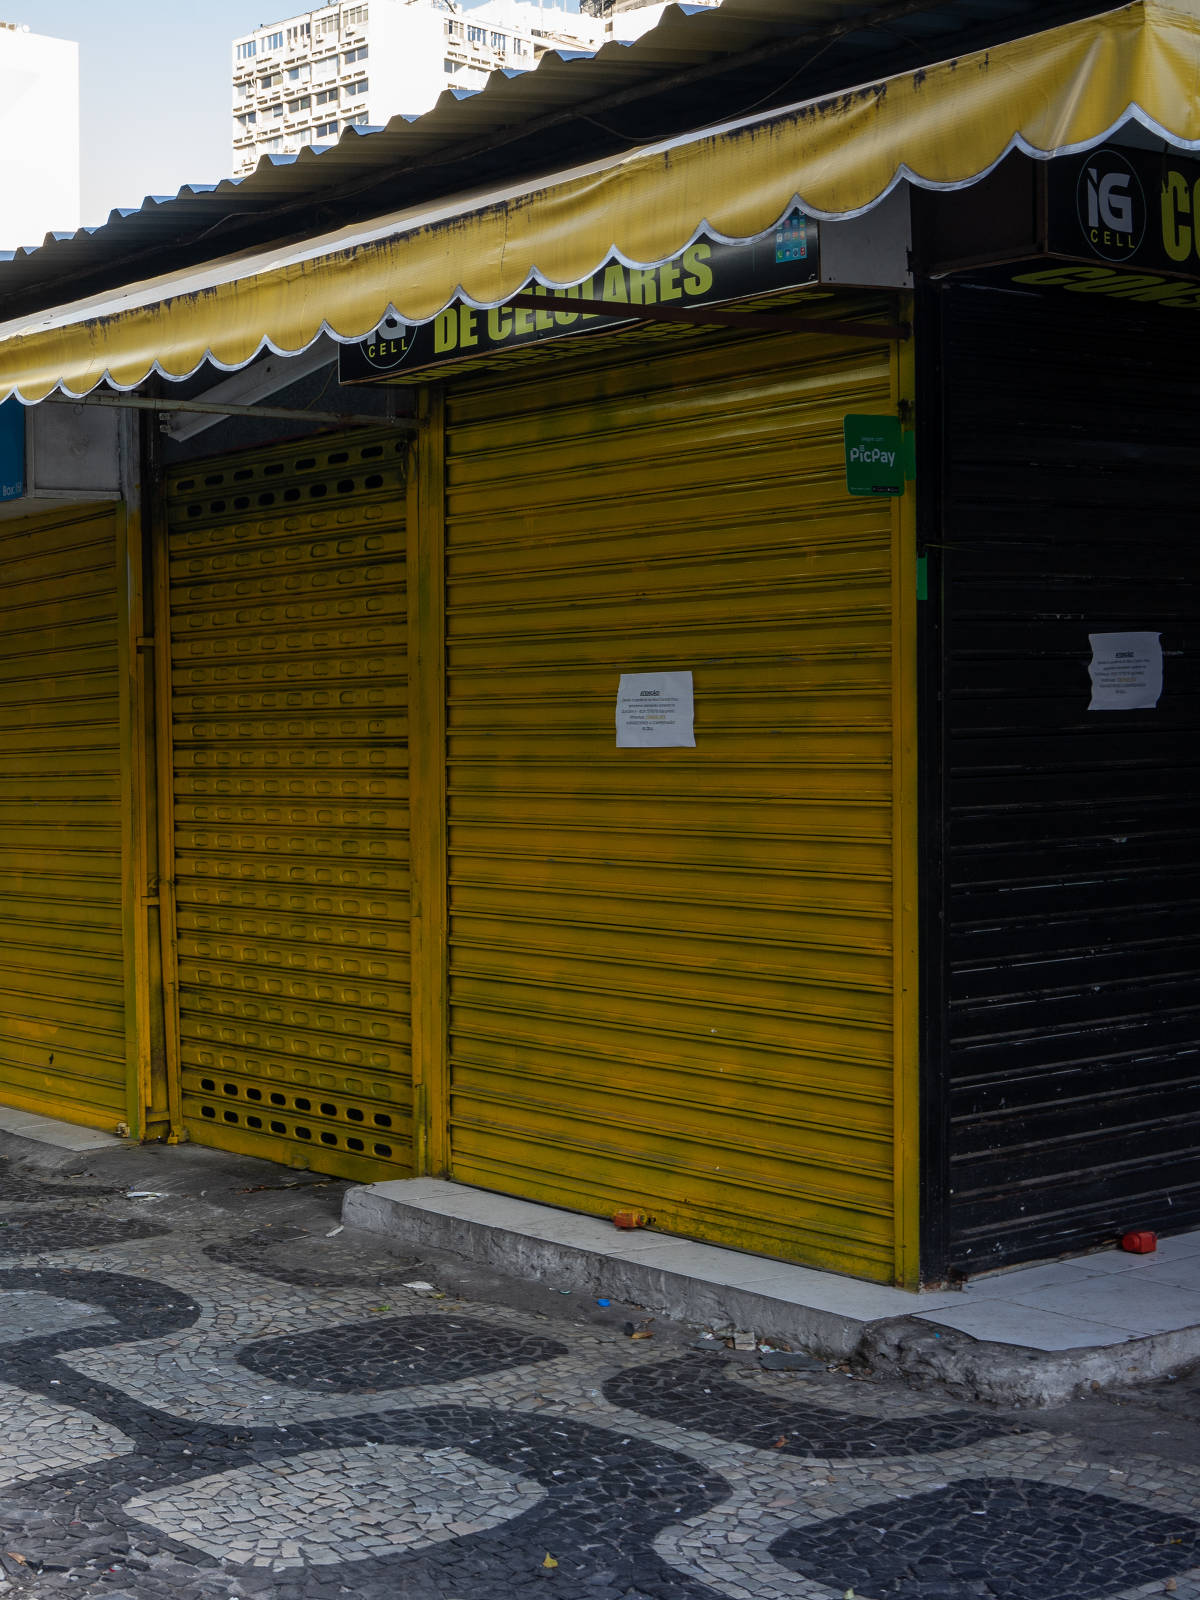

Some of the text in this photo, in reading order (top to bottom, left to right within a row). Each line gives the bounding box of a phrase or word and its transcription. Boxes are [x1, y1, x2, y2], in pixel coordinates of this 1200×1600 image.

[1160, 171, 1200, 262] C
[1090, 229, 1136, 249] CELL
[434, 304, 478, 354] DE
[368, 338, 408, 358] CELL
[849, 445, 896, 468] PicPay
